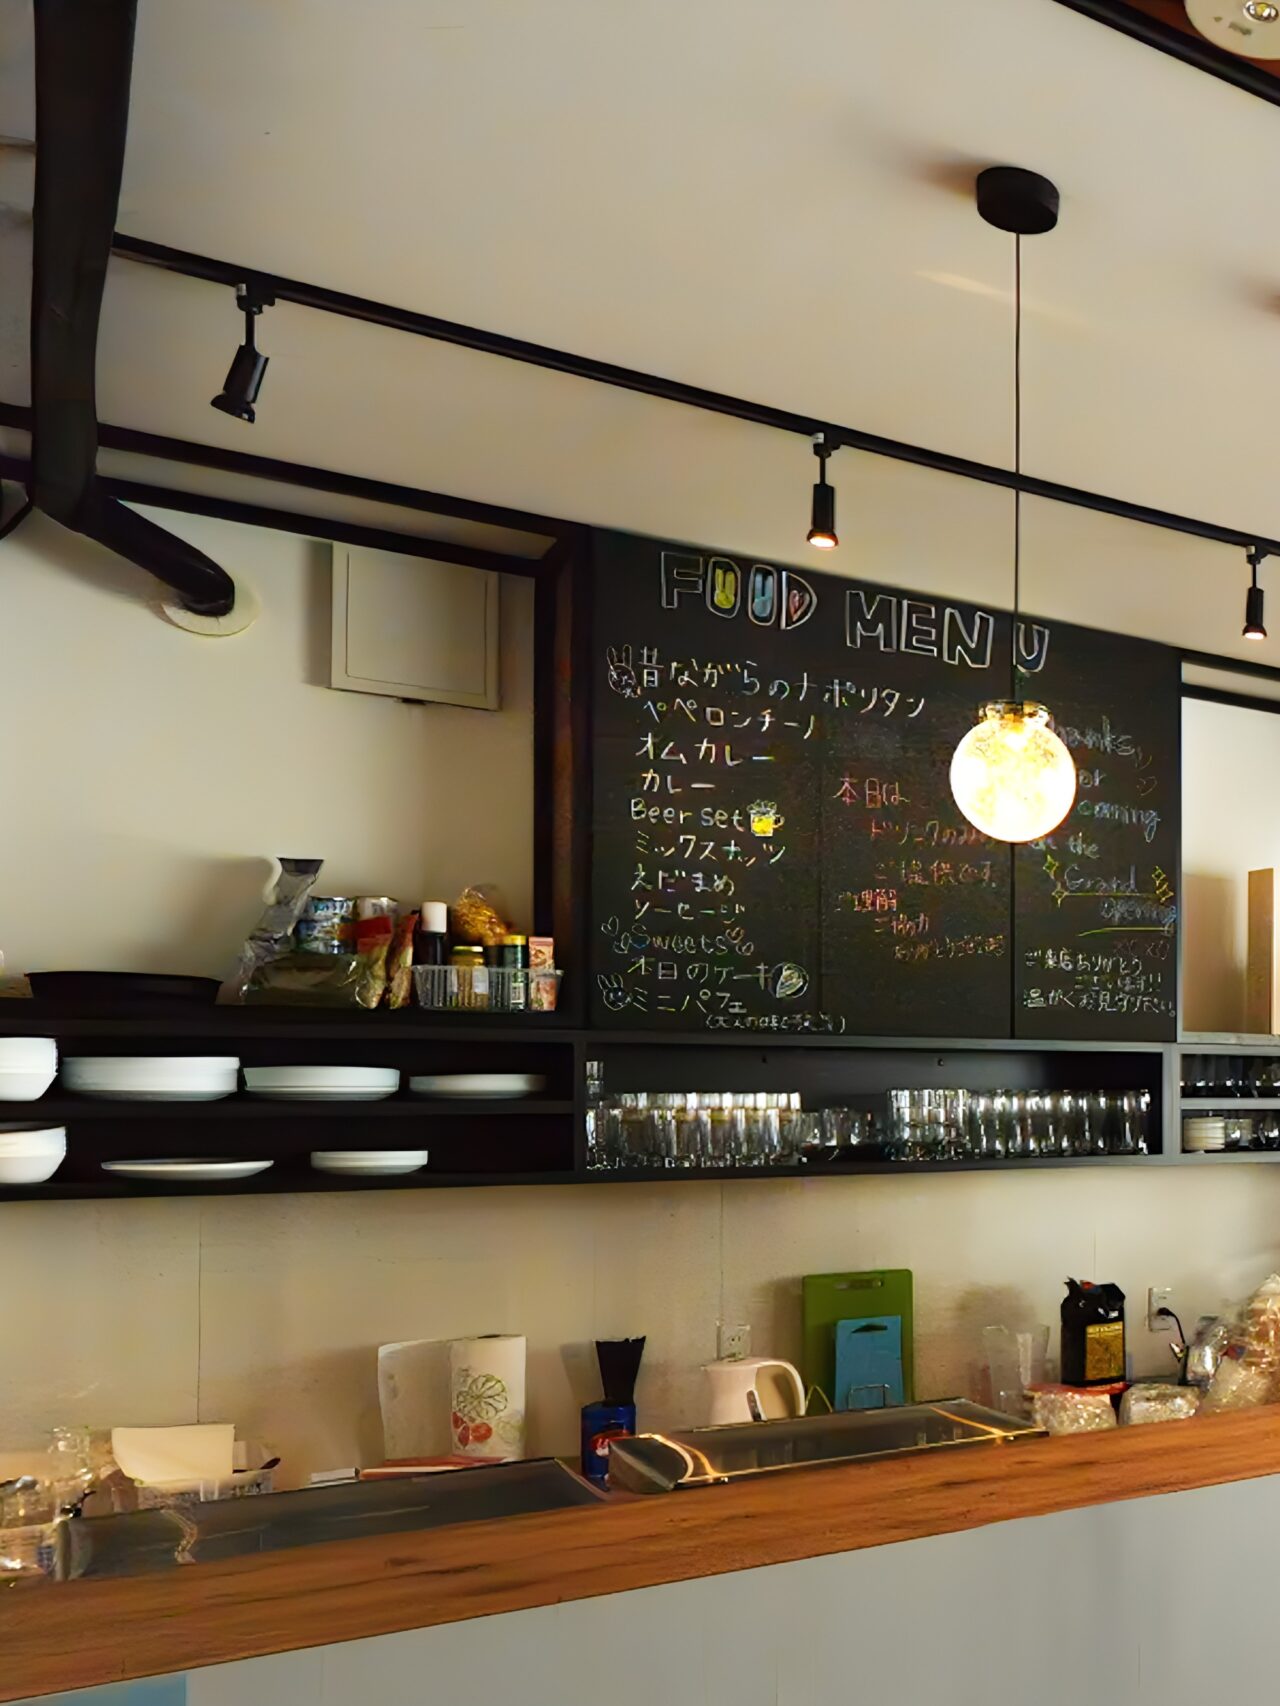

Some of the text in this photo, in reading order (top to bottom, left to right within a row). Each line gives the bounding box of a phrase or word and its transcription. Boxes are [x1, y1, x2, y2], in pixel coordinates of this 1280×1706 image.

[846, 590, 1050, 673] MENU
[635, 731, 775, 767] オムカレー
[641, 768, 716, 794] カレー
[832, 777, 911, 809] 本日は
[630, 797, 745, 832] Beer set
[635, 830, 786, 867] ミックスナッツ
[630, 863, 735, 896] えだまめ
[635, 899, 745, 924] ソーセージ
[632, 986, 748, 1013] ミニパフェ
